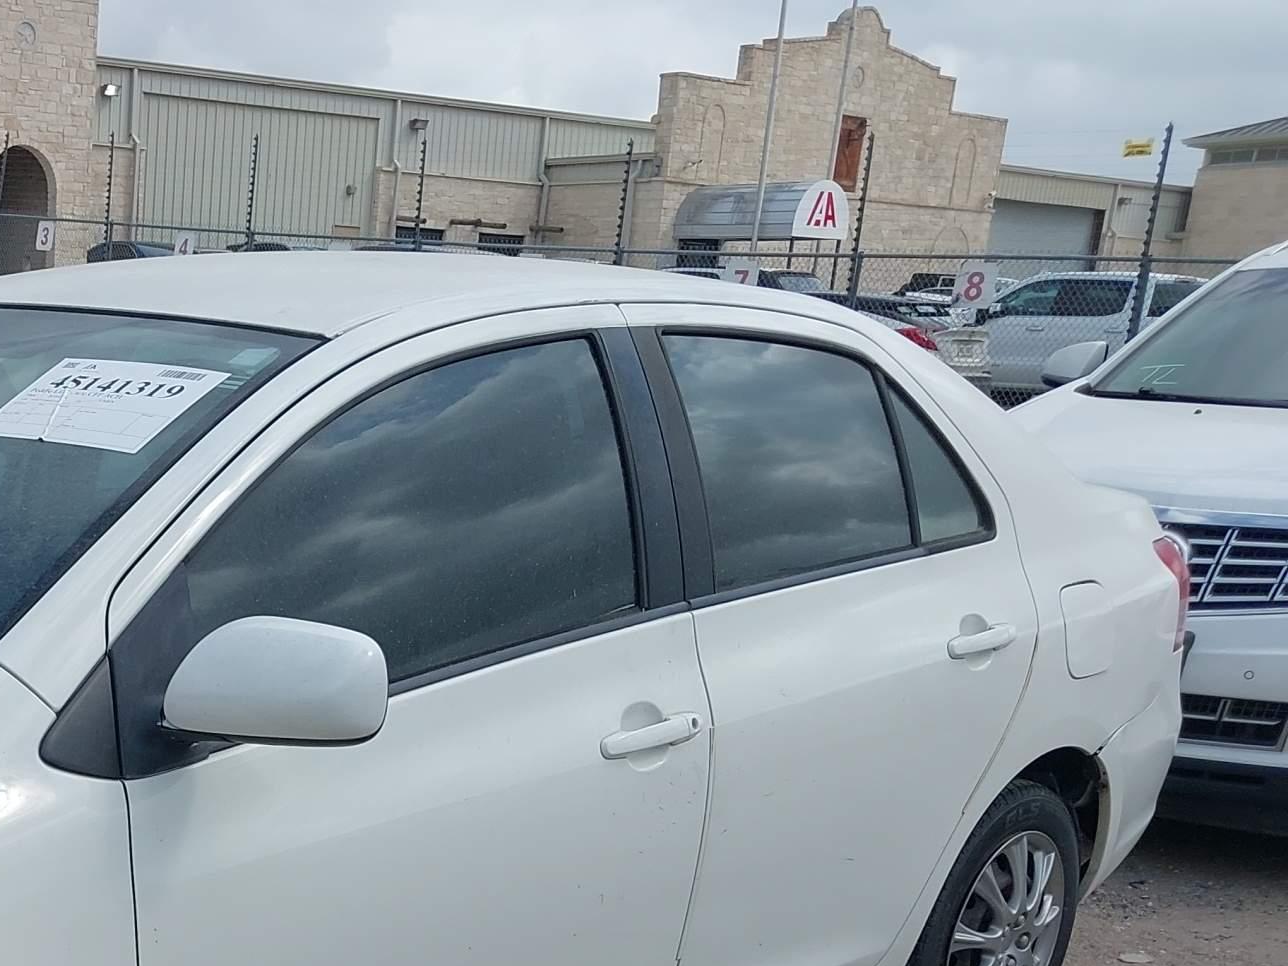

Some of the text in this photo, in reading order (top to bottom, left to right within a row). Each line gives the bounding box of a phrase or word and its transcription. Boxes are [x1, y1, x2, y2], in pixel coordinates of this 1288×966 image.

[40, 227, 50, 246] 3
[179, 238, 189, 255] 4
[734, 269, 749, 284] 7
[963, 271, 985, 301] 8
[49, 374, 185, 399] 45141319
